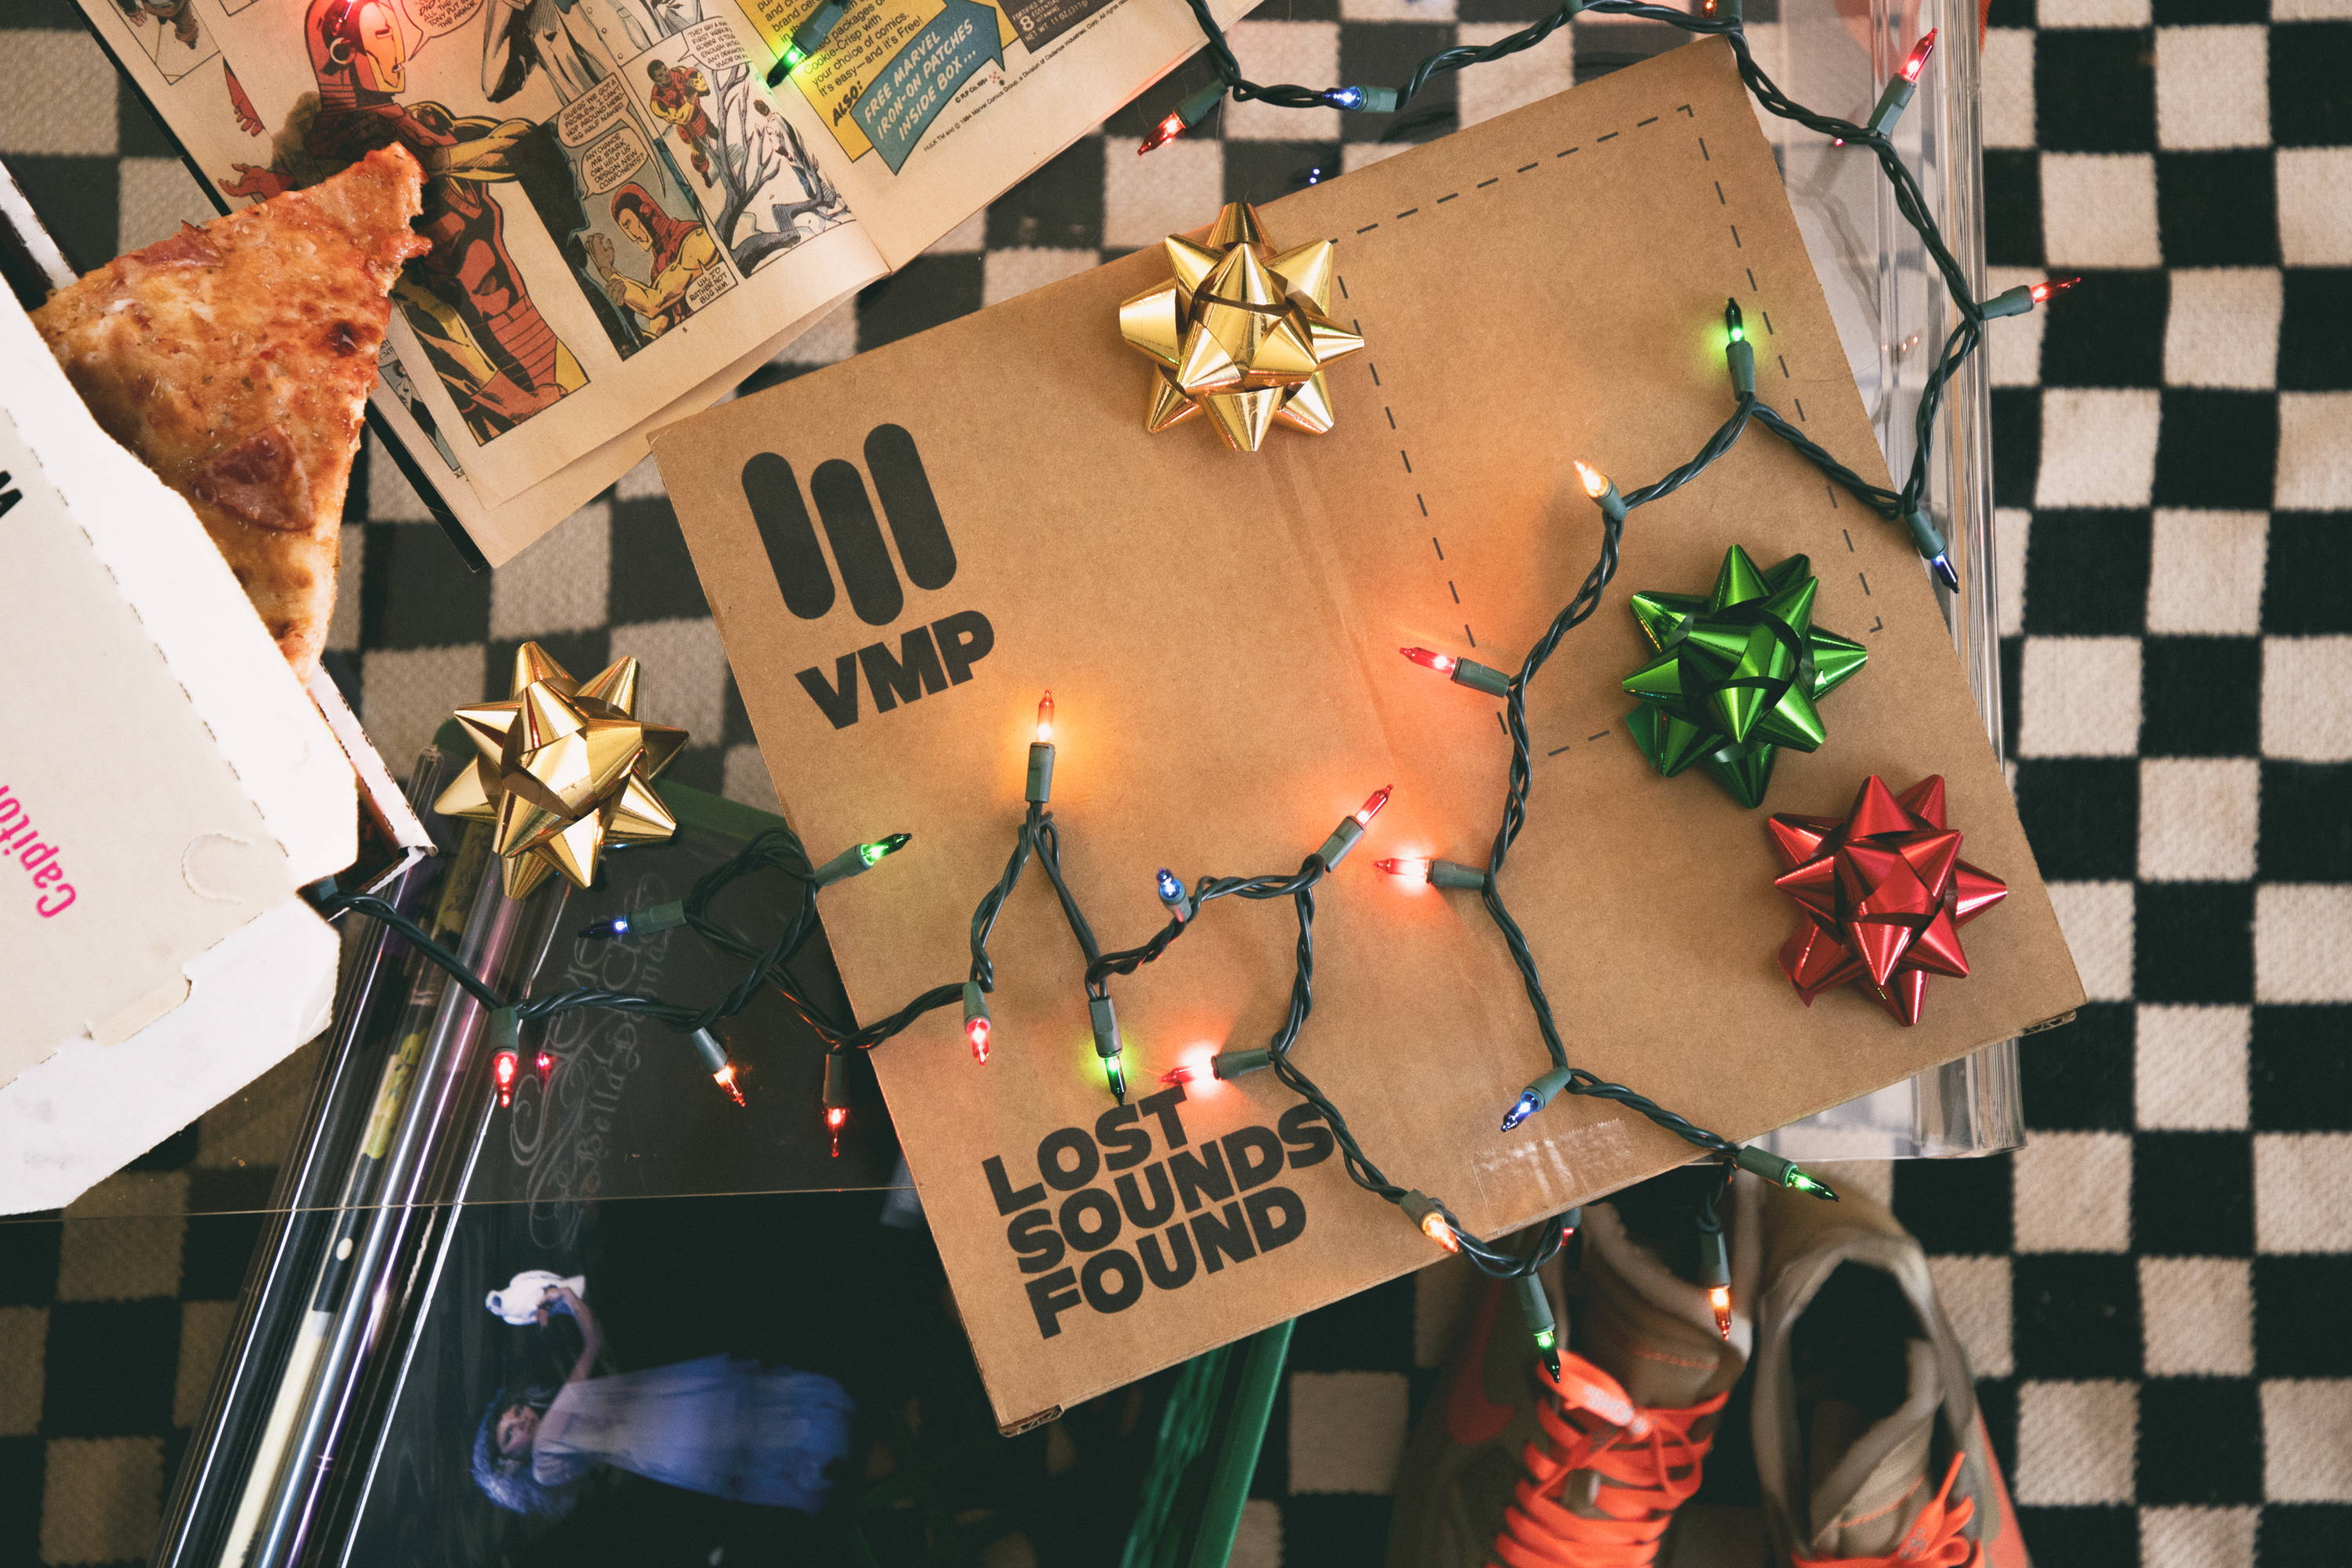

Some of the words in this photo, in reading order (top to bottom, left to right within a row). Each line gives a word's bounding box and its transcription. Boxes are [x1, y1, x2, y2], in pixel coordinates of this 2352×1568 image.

[424, 11, 437, 22] ALL
[437, 0, 452, 10] THE
[428, 13, 445, 26] TONY
[446, 2, 459, 14] PUT
[438, 16, 452, 27] THE
[765, 3, 784, 21] and
[771, 7, 800, 31] brand
[831, 4, 875, 42] packages
[1020, 16, 1034, 31] 8
[688, 27, 702, 37] THEY
[691, 33, 710, 44] FIRST
[695, 38, 717, 51] SOBER
[780, 33, 790, 42] in
[804, 30, 862, 74] Cookie-Crisp
[862, 14, 882, 31] with
[1025, 31, 1038, 42] NET
[700, 44, 726, 58] ENOUGH
[707, 54, 720, 64] ANY
[716, 56, 733, 68] MADE
[812, 67, 833, 89] your
[833, 45, 864, 71] choice
[864, 34, 874, 48] of
[875, 12, 909, 39] comics.
[818, 83, 835, 97] It's
[883, 35, 898, 49] it's
[898, 16, 924, 39] Free!
[865, 82, 894, 123] FREE
[894, 31, 942, 87] MARVEL
[877, 73, 922, 140] IRON-ON
[923, 19, 973, 78] PATCHES
[564, 100, 586, 120] GUESS
[586, 93, 597, 103] WE
[598, 83, 612, 96] GOT
[564, 104, 597, 128] PROBLEM.
[604, 86, 620, 100] CAN'T
[833, 81, 863, 127] ALSO:
[898, 85, 937, 141] INSIDE
[924, 140, 938, 151] HULK
[946, 127, 955, 136] and
[971, 103, 988, 115] Marvel
[987, 91, 1004, 104] Comics
[1022, 63, 1040, 78] Division
[1045, 45, 1065, 60] Cadence
[565, 125, 579, 137] HOP
[581, 106, 607, 127] AROUND
[571, 132, 583, 142] ING
[585, 120, 600, 136] HALF
[586, 151, 597, 162] ANY
[597, 132, 621, 153] CHANCE
[590, 165, 604, 177] CAN
[604, 151, 622, 169] HELP
[621, 144, 631, 155] US
[591, 156, 604, 168] MR.
[604, 138, 626, 158] STARK
[594, 162, 621, 183] DESIGN
[621, 149, 637, 166] NEW
[599, 152, 644, 190] COMPONENTS?
[689, 282, 713, 301] RATHER
[713, 271, 728, 284] NOT
[699, 290, 714, 304] BUG
[794, 610, 995, 730] VMP
[982, 1084, 1189, 1217] LOST
[1007, 1102, 1335, 1274] SOUNDS
[1025, 1186, 1307, 1340] FOUND
